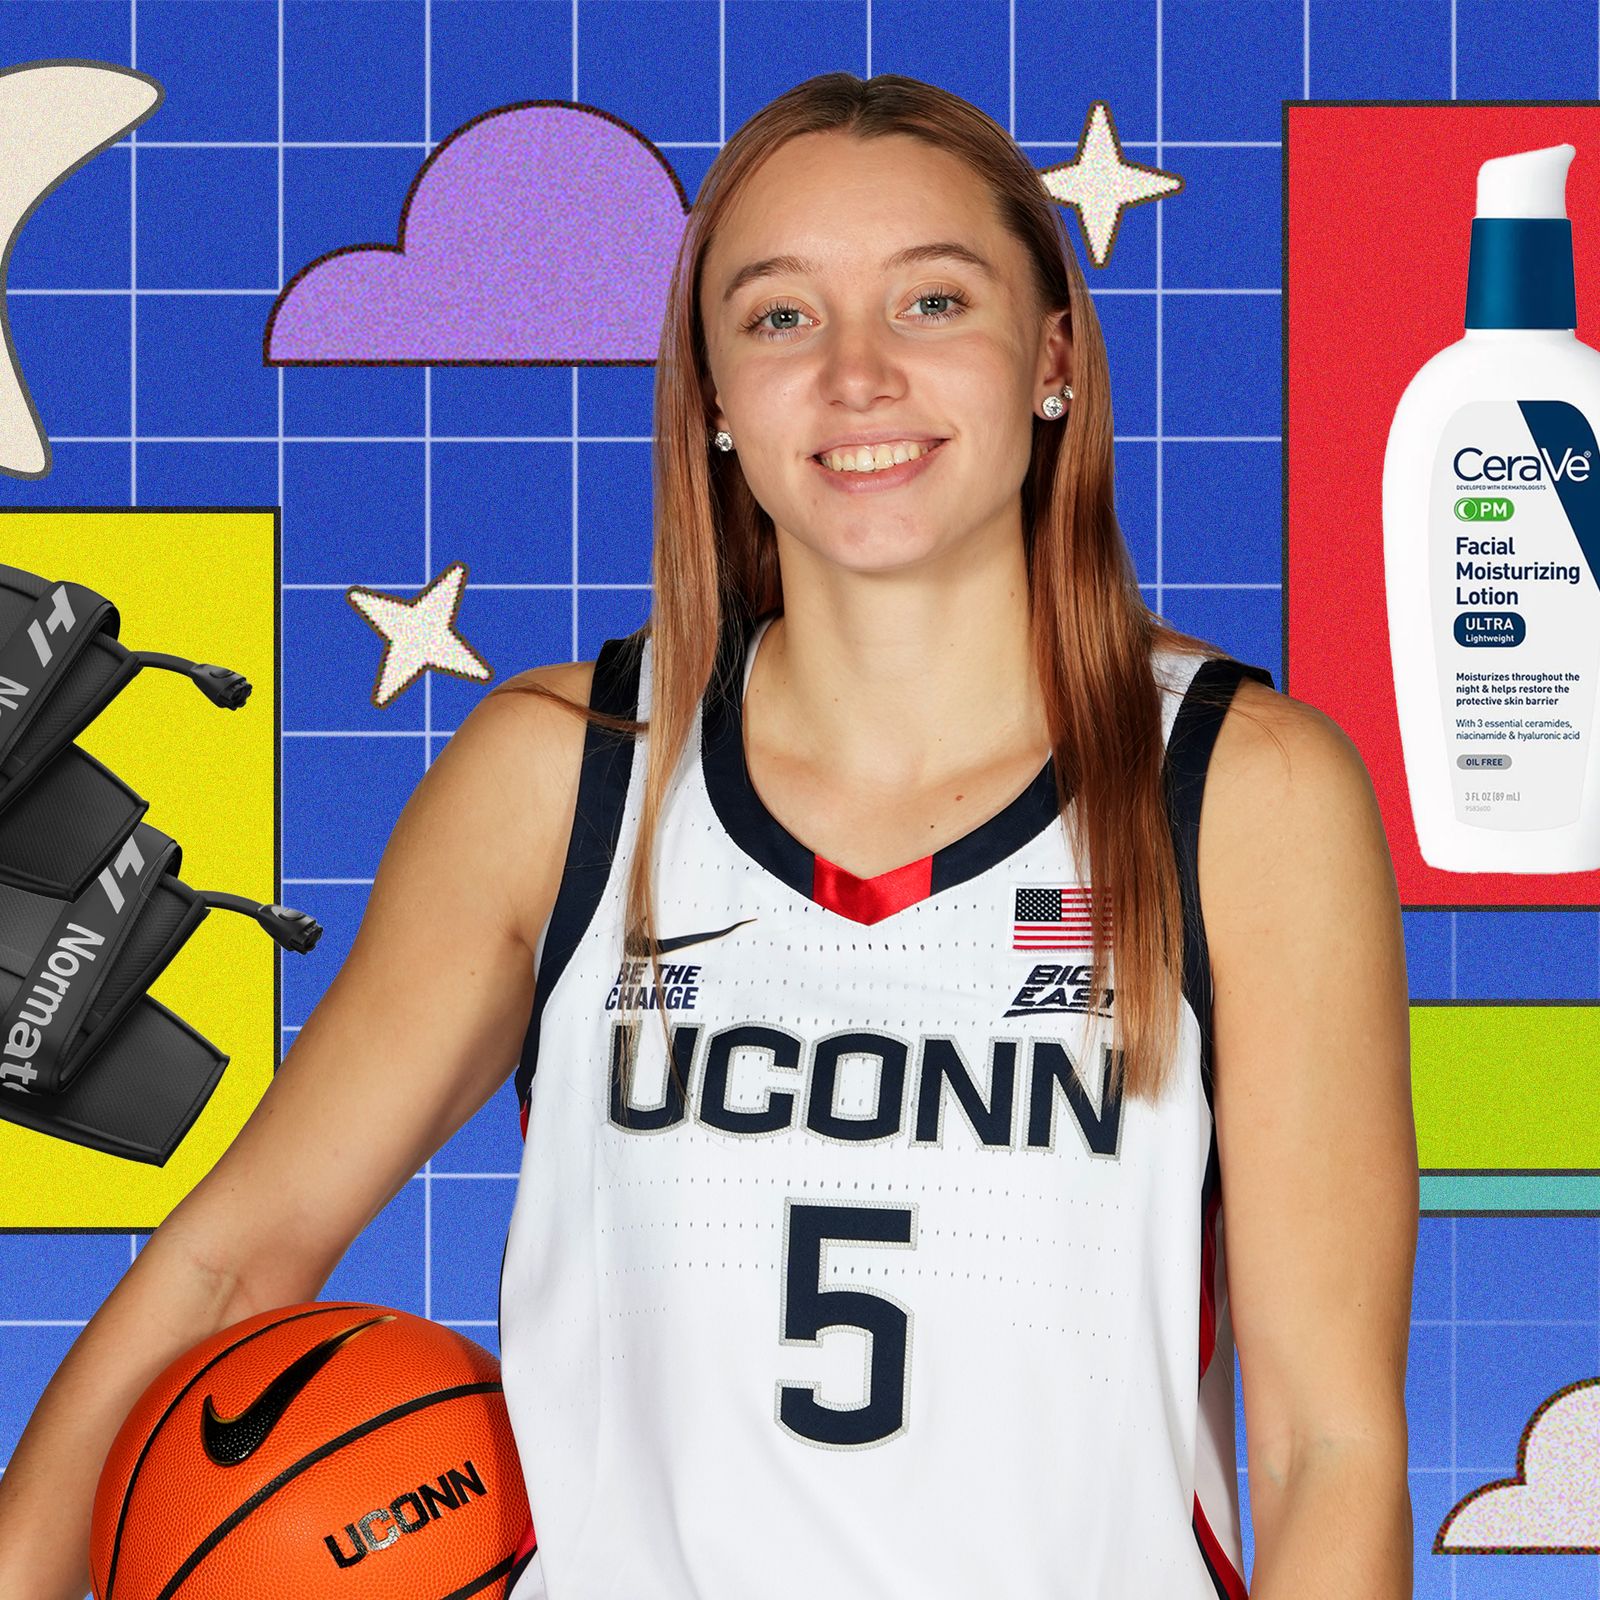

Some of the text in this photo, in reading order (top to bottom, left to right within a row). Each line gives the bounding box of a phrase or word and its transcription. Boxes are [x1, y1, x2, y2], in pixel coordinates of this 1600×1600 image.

[1480, 502, 1508, 518] PM
[1456, 537, 1515, 555] Facial
[1456, 562, 1580, 585] Moisturizing
[1456, 587, 1518, 605] Lotion
[1465, 618, 1514, 630] ULTRA
[1465, 634, 1514, 644] Lightweight
[1456, 672, 1580, 683] Moisturizes throughout the
[1456, 685, 1480, 694] night
[1482, 685, 1489, 694] &
[1492, 685, 1516, 694] helps
[1554, 685, 1570, 693] the
[1456, 697, 1558, 706] protective skin barrier
[1456, 719, 1572, 728] With 3 essential ceramides,
[1456, 731, 1580, 742] niacinamide & hyaluronic acid
[1465, 792, 1470, 800] 3
[1472, 792, 1480, 800] FL
[1482, 792, 1491, 800] OZ
[652, 963, 702, 985] THE
[604, 986, 699, 1010] CHANGE
[0, 922, 106, 1095] Normat
[607, 1020, 1127, 1160] UCONN
[774, 1196, 920, 1452] 5
[323, 1460, 487, 1569] UCONN
